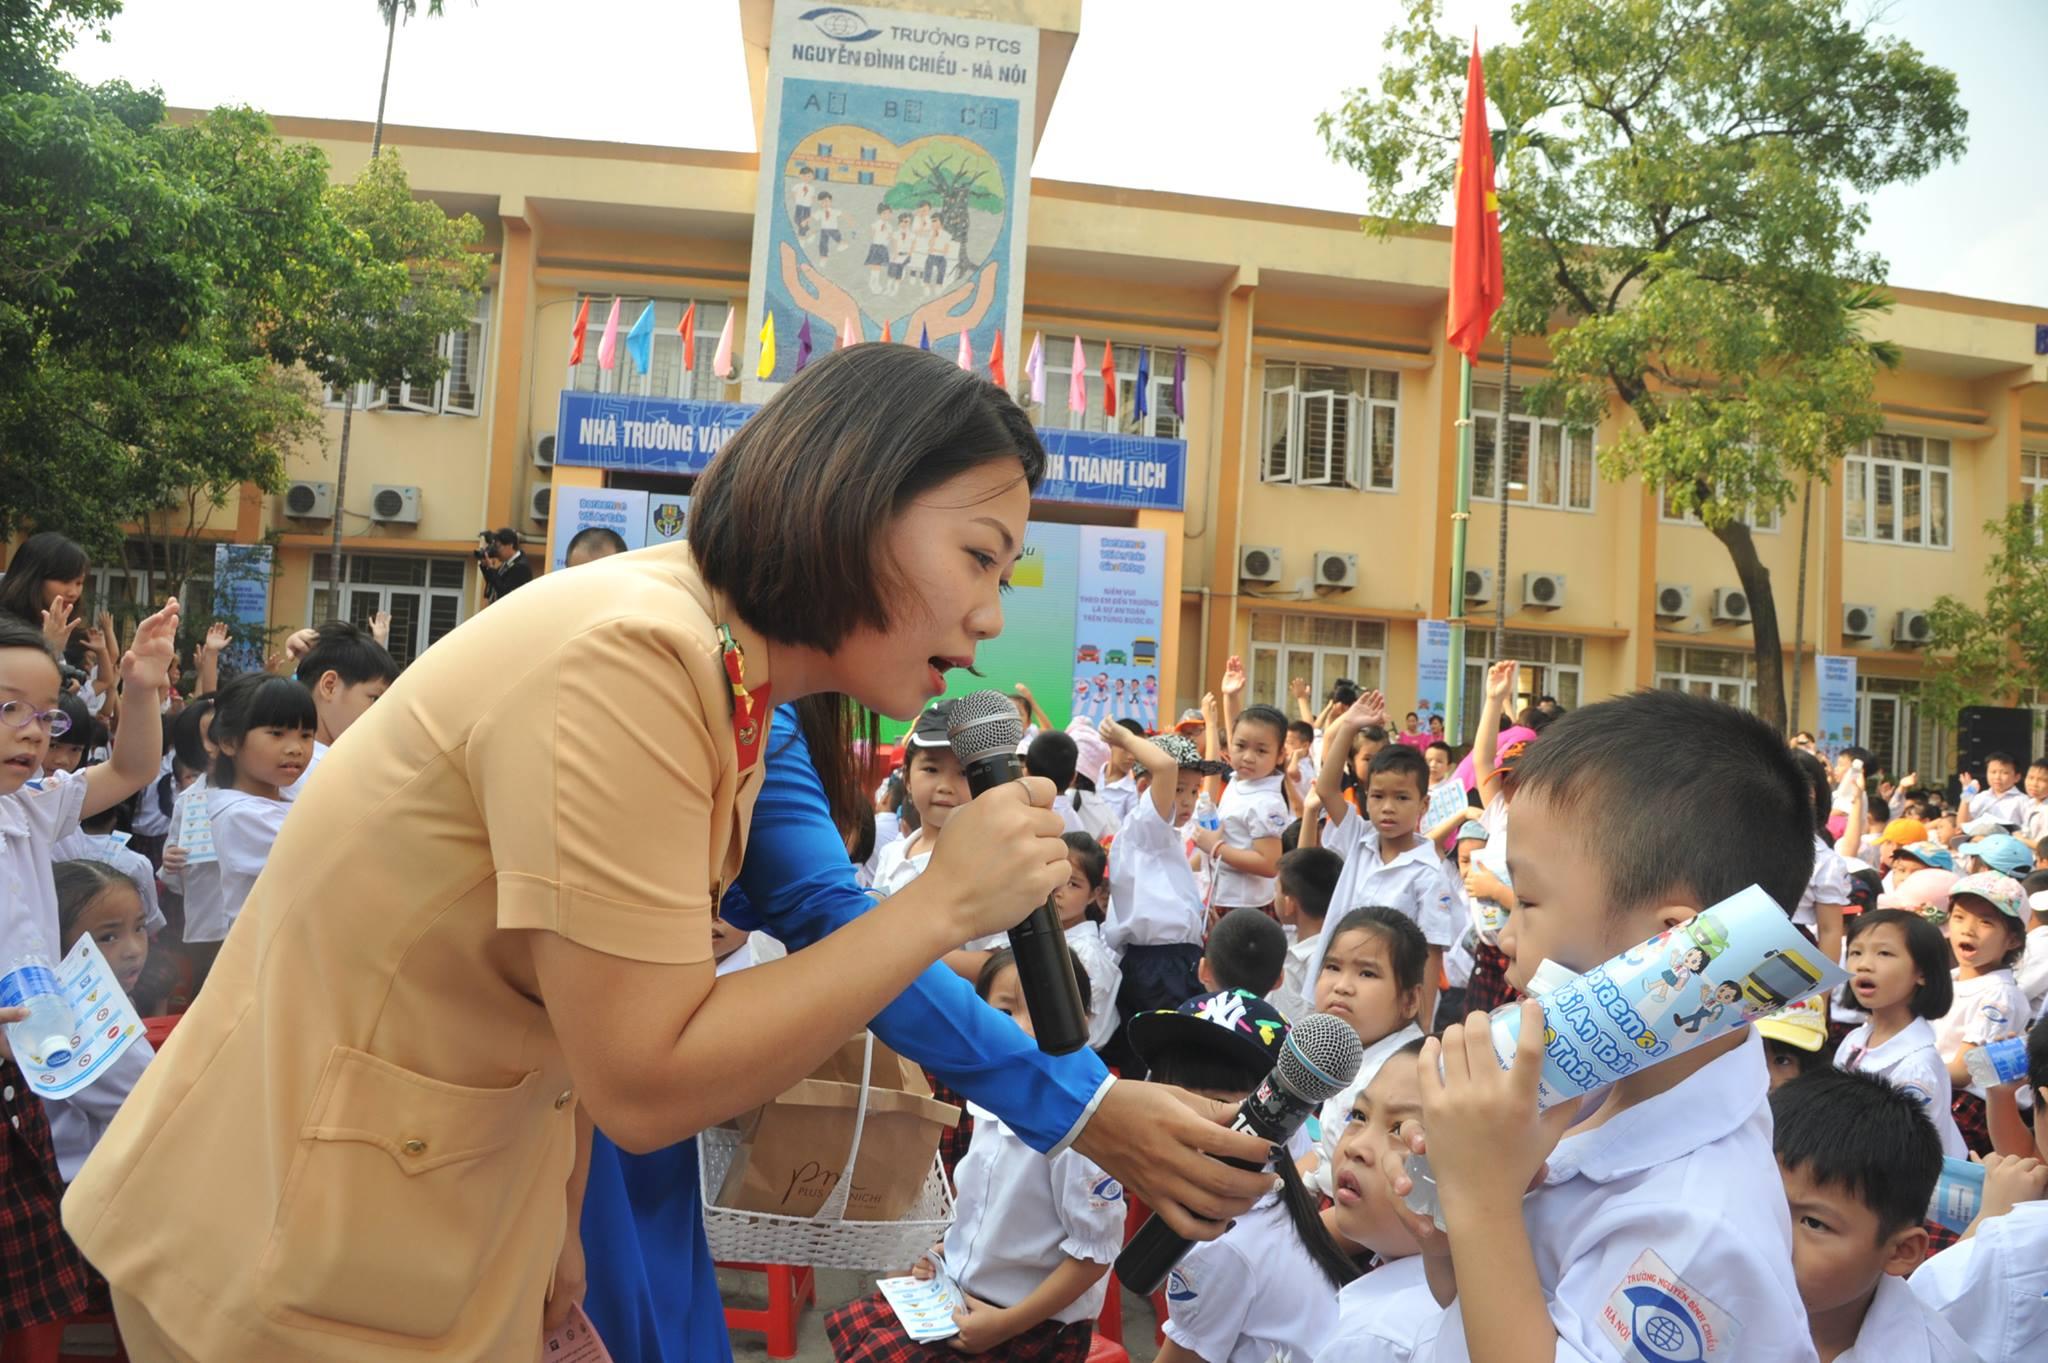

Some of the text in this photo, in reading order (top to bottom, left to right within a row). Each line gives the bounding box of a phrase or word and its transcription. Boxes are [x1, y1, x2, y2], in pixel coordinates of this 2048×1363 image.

[890, 26, 1021, 55] TRƯỜNG PTCS
[792, 43, 861, 66] NGUYỄN
[864, 48, 904, 70] ĐÌNH
[972, 60, 993, 80] HÀ
[804, 94, 976, 125] A B C
[579, 414, 617, 447] NHÀ
[623, 416, 693, 452] TRƯỜNG
[1068, 455, 1124, 486] THANH
[1128, 460, 1167, 493] LỊCH
[1565, 1005, 1599, 1043] An
[1548, 1034, 1607, 1091] Thôn
